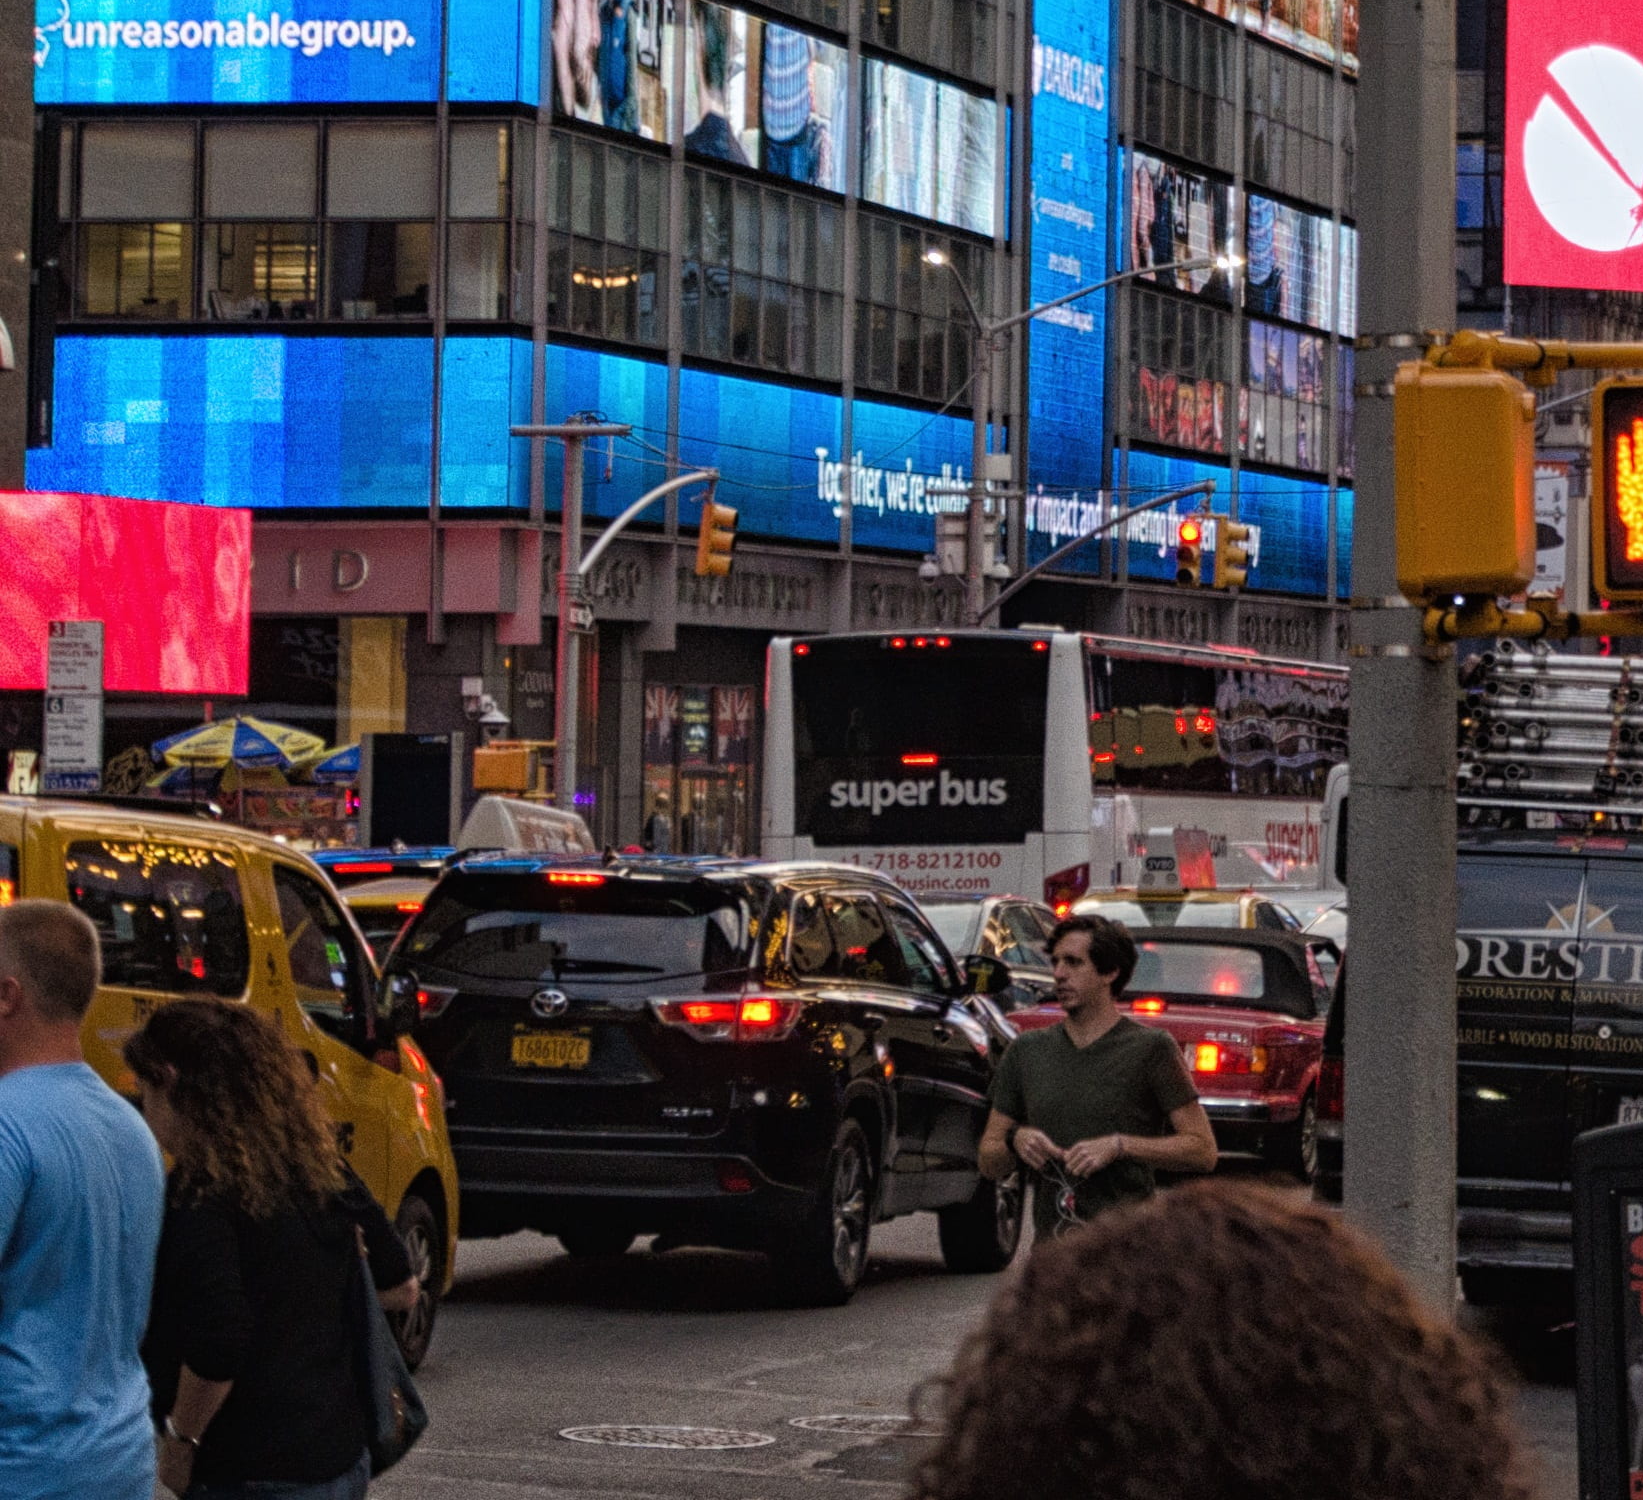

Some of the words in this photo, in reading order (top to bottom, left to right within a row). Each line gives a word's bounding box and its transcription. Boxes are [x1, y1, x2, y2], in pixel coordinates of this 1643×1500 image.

[64, 13, 415, 55] unreasonablegroup.
[815, 447, 885, 517] Togther,
[830, 775, 935, 814] super
[941, 770, 1008, 808] bus
[1456, 986, 1557, 1003] ESTORATION
[1456, 1027, 1496, 1046] ARBLE
[1508, 1030, 1551, 1049] WOOD
